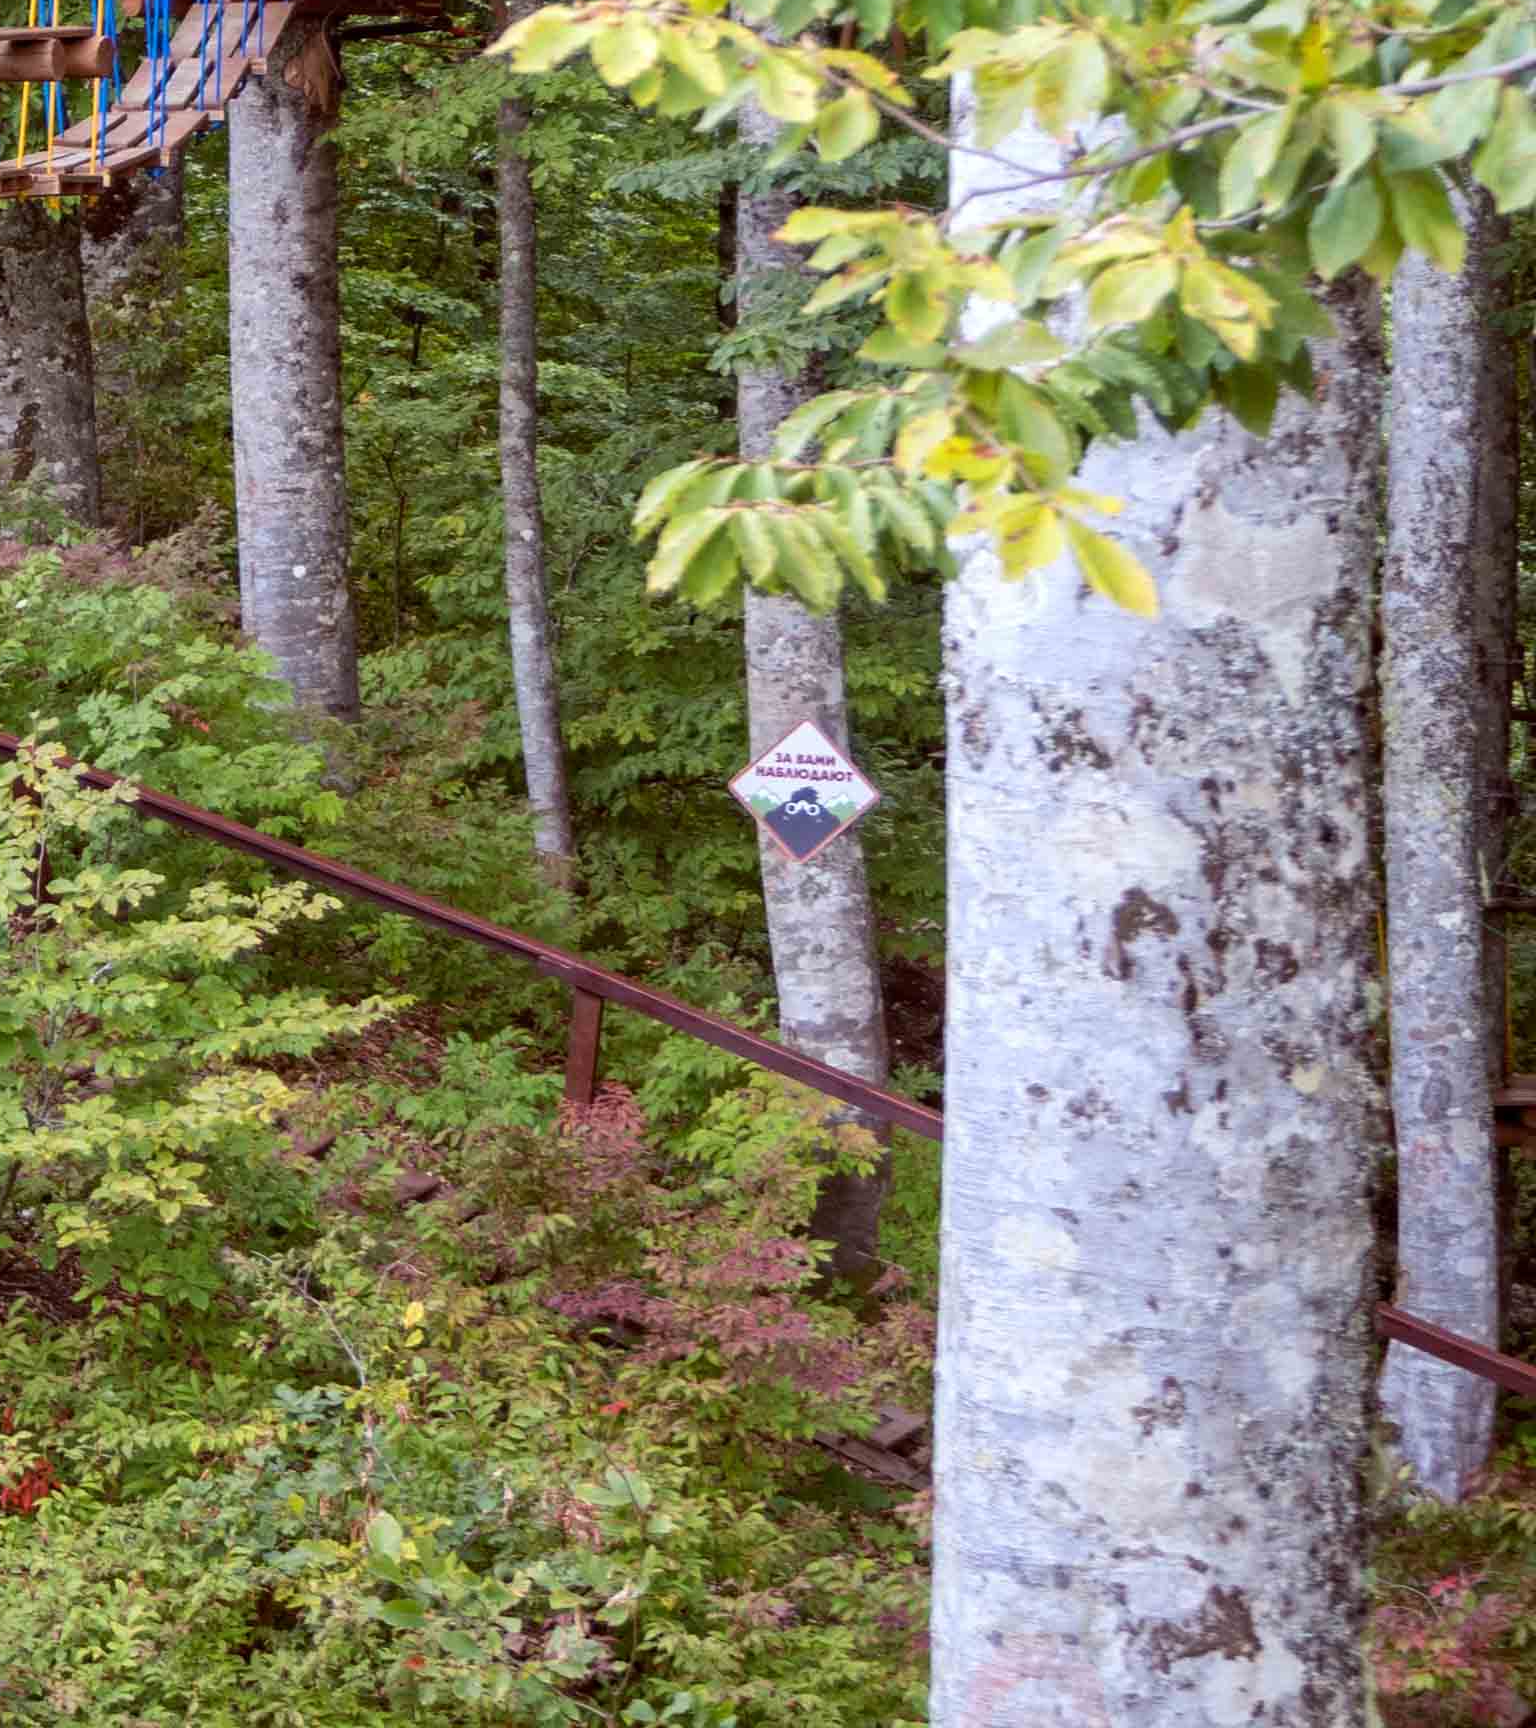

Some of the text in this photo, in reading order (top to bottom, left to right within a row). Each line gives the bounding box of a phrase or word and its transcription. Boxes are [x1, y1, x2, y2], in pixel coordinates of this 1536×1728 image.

[775, 752, 836, 766] ЗА ВАМИ
[755, 766, 854, 782] НАБЛЮДАЮТ
